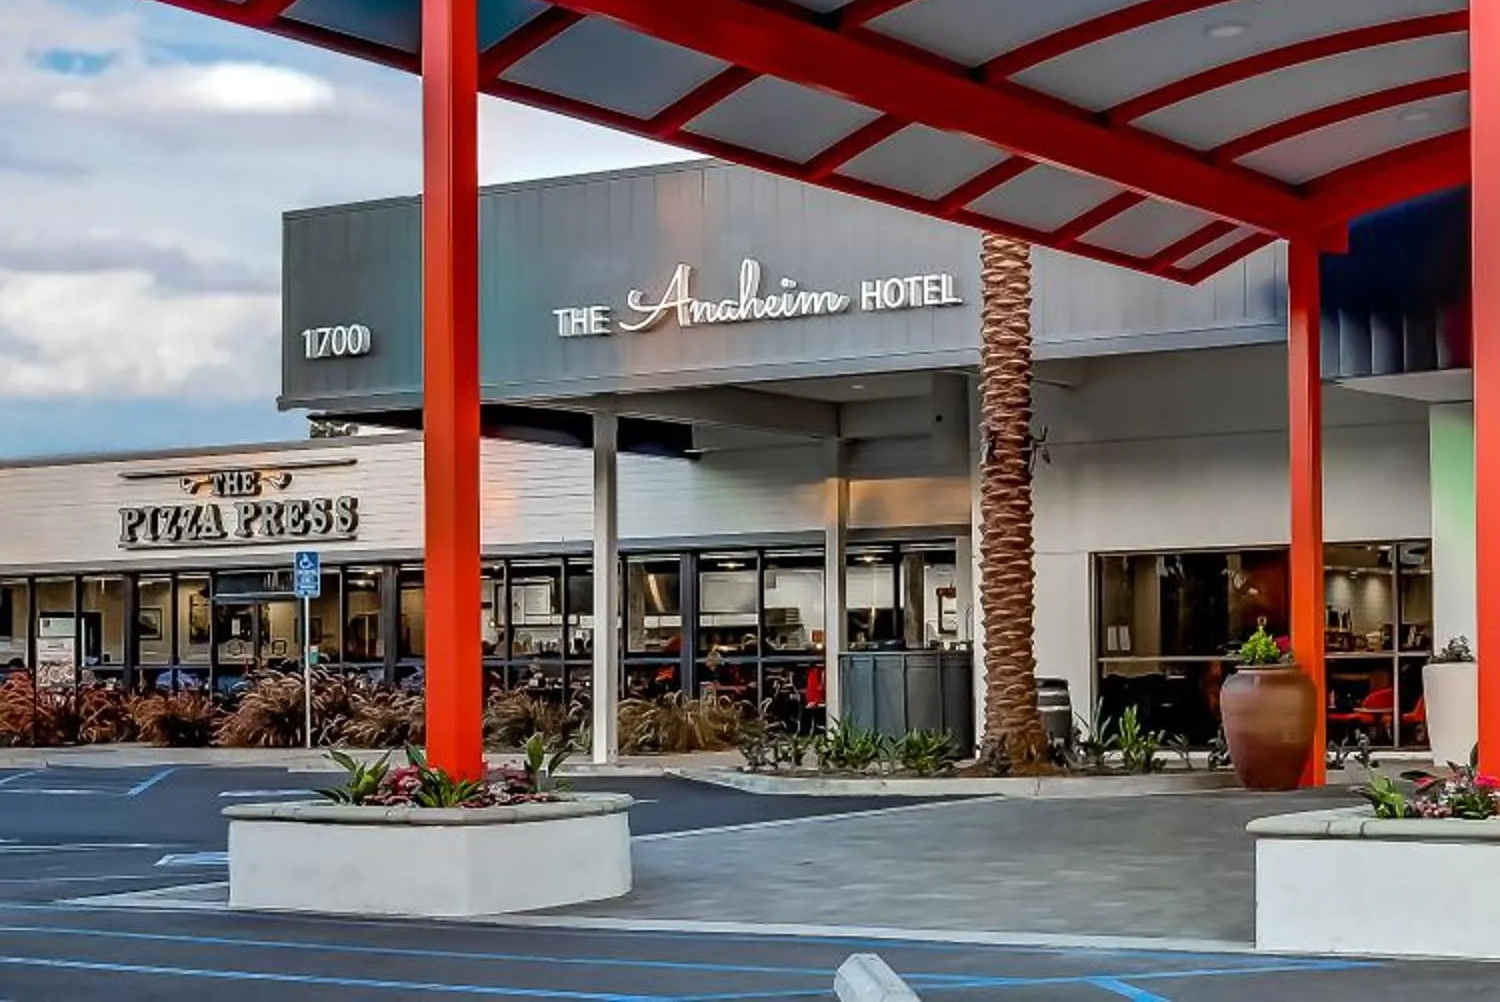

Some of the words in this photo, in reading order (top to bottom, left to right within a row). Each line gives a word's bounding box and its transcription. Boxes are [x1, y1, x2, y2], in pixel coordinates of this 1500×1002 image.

[552, 305, 612, 338] THE
[618, 258, 850, 332] Anaheim
[861, 273, 964, 311] HOTEL
[301, 324, 371, 359] 1700
[210, 471, 262, 496] THE
[118, 502, 228, 543] PIZZA
[233, 496, 358, 539] PRESS
